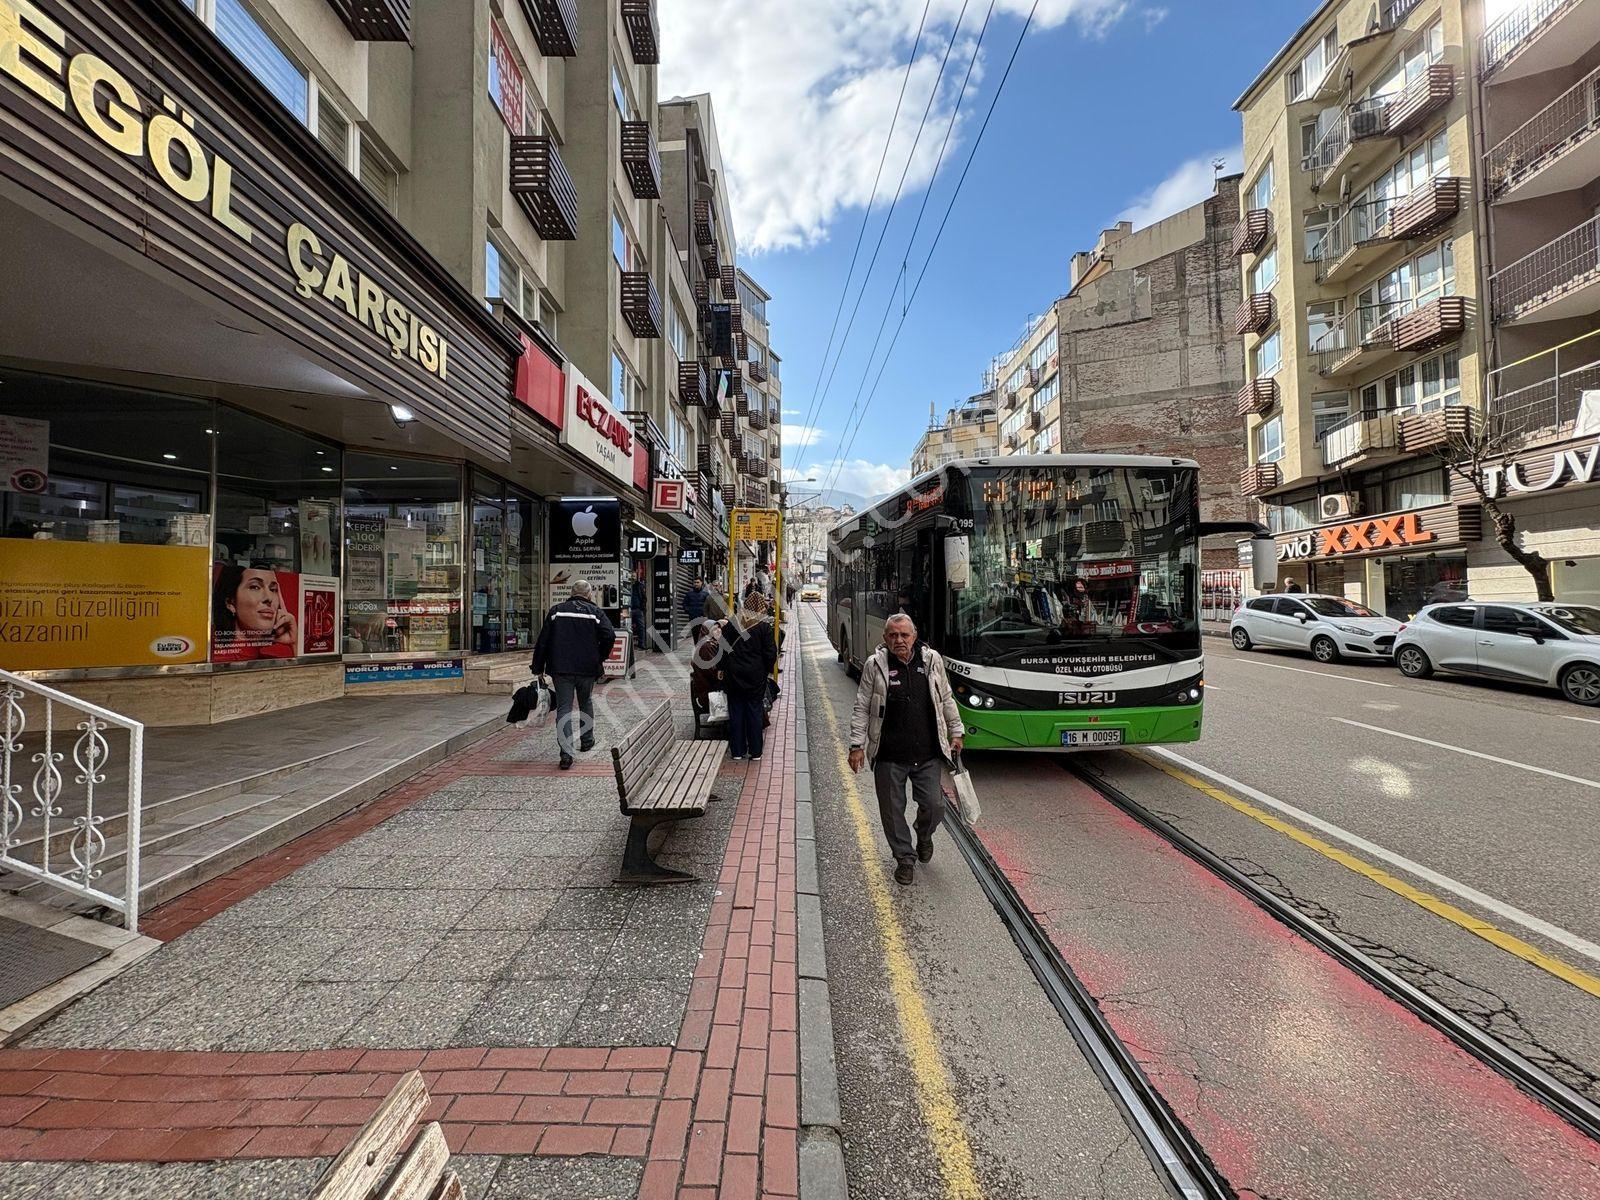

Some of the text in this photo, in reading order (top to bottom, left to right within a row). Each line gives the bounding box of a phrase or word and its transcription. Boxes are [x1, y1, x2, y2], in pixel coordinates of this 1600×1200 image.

[287, 222, 448, 381] ÇARŞISI
[576, 384, 633, 458] ECZANE
[595, 441, 616, 464] YAŞAM
[660, 486, 678, 506] E
[1320, 514, 1435, 555] XXXL
[629, 537, 656, 552] JET
[56, 597, 159, 620] Güzelliğini
[1108, 653, 1156, 662] BELEDİYESİ
[946, 660, 972, 676] 7095
[1055, 663, 1123, 674] ÖZEL HALK OTOBÜSÜ
[1058, 692, 1117, 705] ISUZU
[1068, 731, 1119, 743] 16 M 00095
